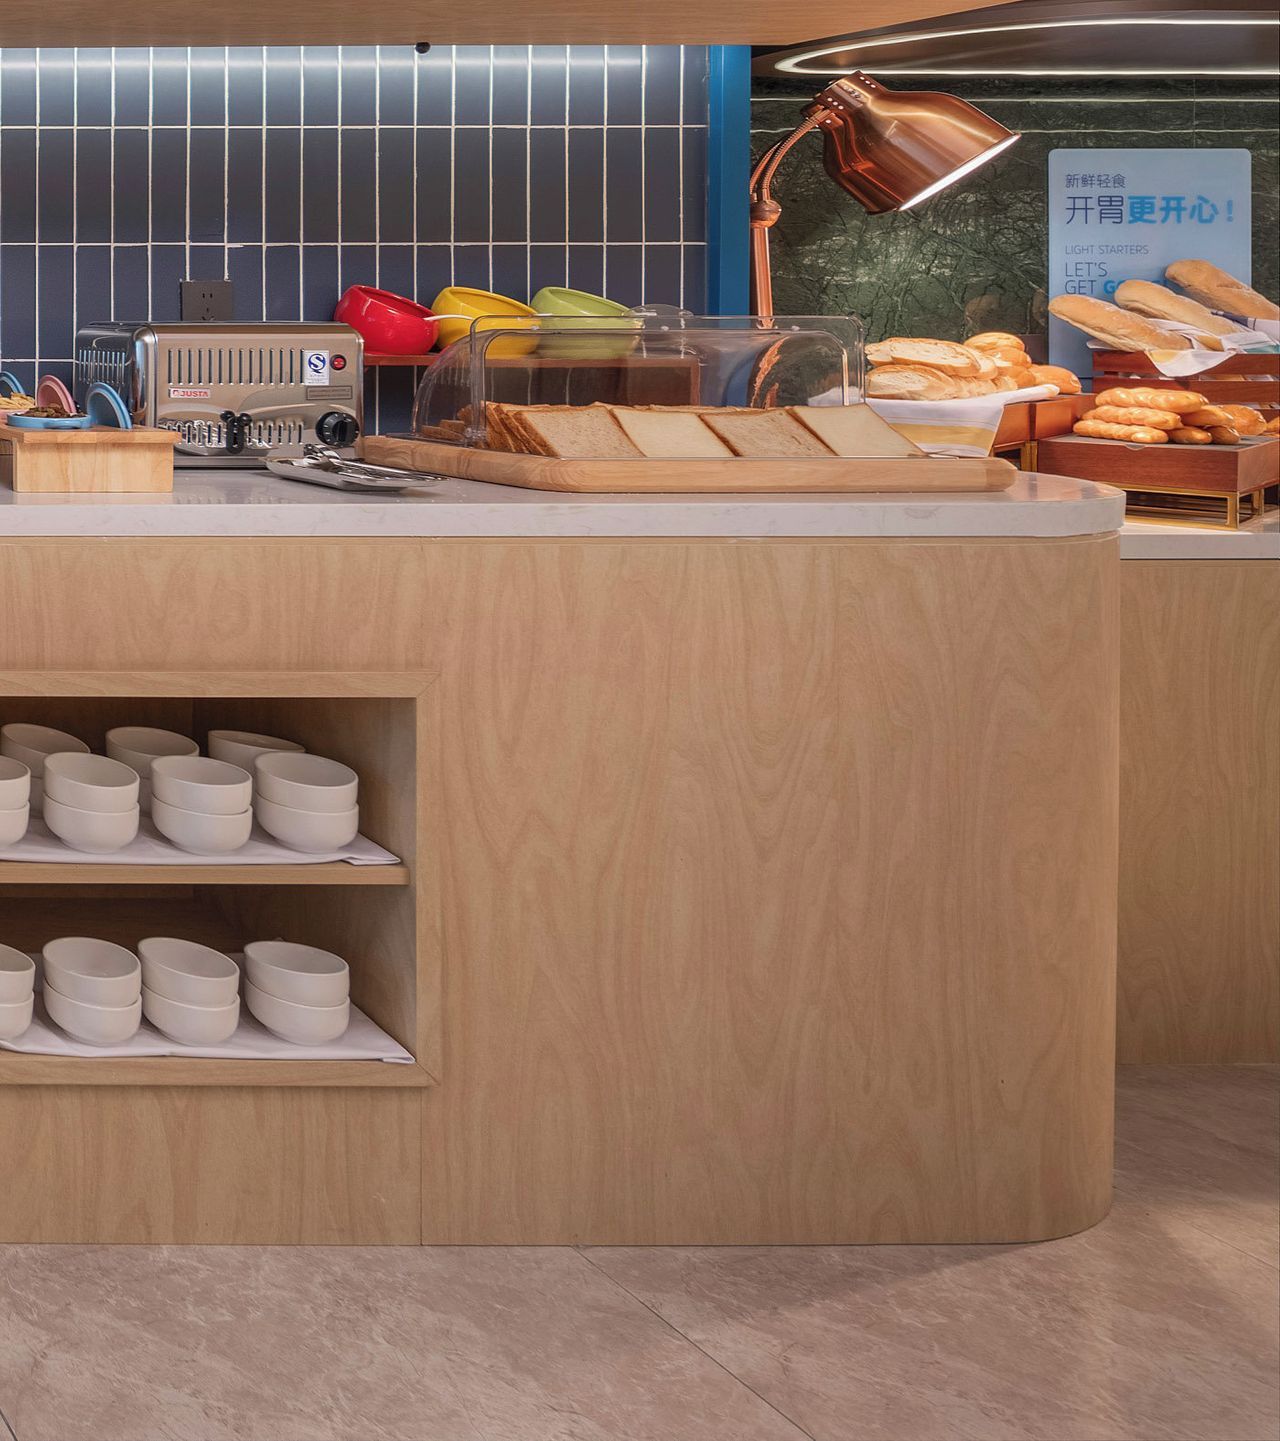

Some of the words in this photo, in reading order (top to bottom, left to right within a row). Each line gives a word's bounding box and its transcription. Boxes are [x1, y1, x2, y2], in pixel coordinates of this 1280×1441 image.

[1064, 173, 1127, 189] 新鲜轻食
[1064, 194, 1235, 225] 开胃更开心！
[1065, 244, 1095, 255] LIGHT
[1098, 244, 1150, 255] STARTERS
[1064, 261, 1108, 277] LET'S
[1064, 279, 1097, 295] GET
[179, 389, 209, 398] JUSTA
